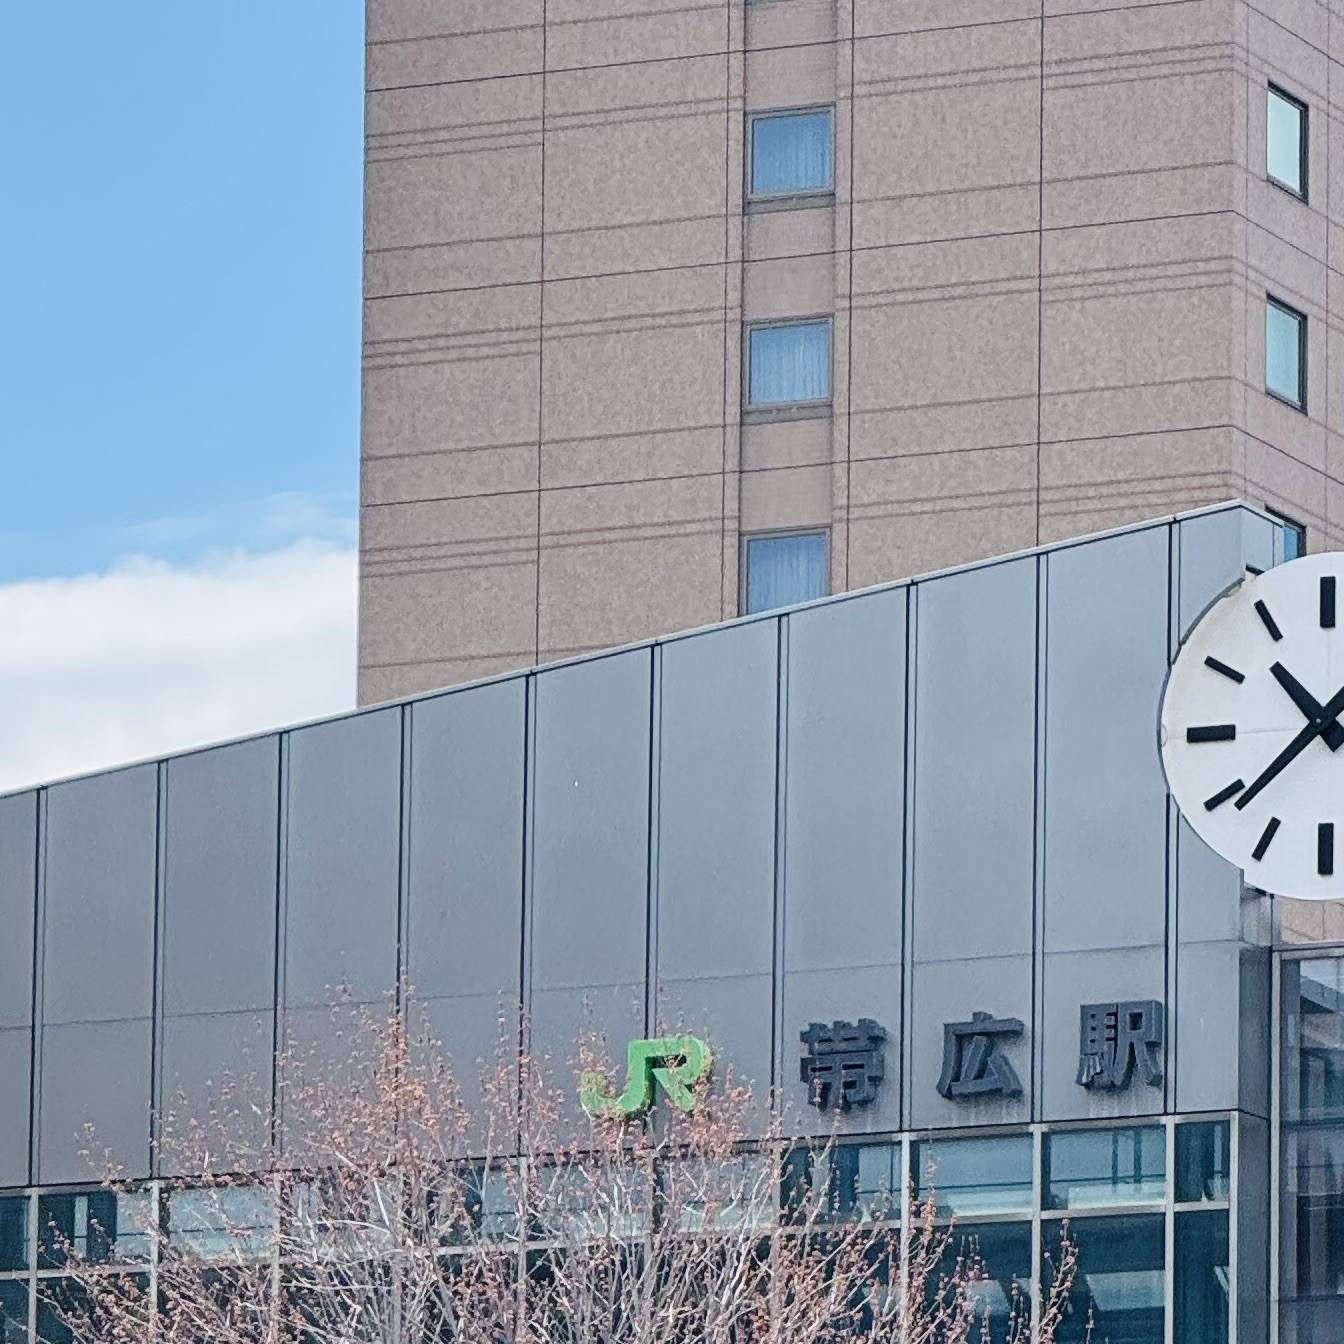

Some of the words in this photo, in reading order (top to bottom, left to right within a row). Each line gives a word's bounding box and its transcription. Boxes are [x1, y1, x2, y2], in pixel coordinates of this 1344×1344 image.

[580, 1035, 712, 1120] JR
[799, 999, 1164, 1112] 帯広駅
